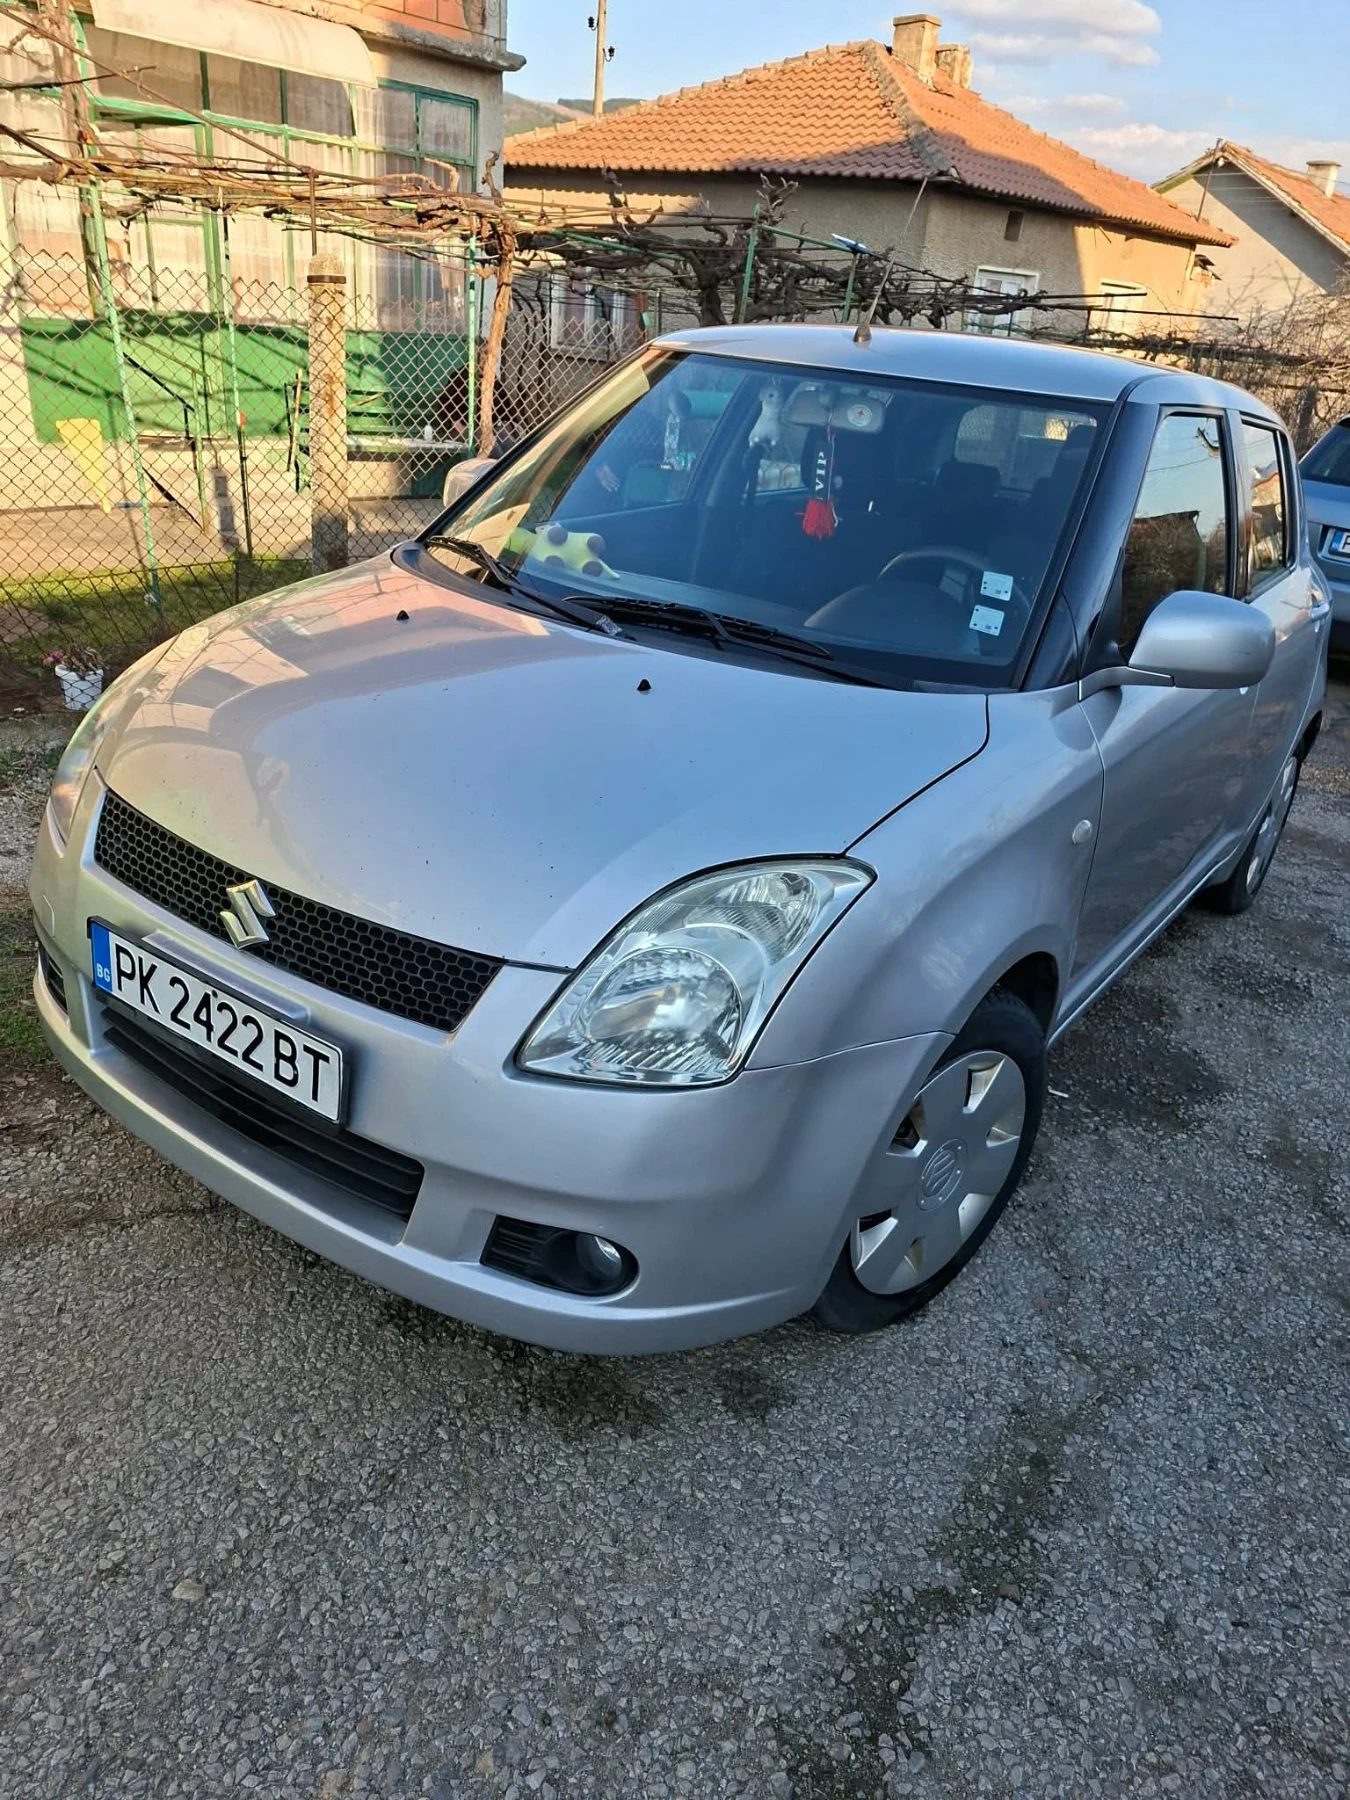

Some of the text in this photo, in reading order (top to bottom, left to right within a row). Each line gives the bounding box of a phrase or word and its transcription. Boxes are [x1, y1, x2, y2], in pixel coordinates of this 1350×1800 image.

[96, 962, 111, 983] BG
[114, 942, 331, 1102] PK 2422 BT
